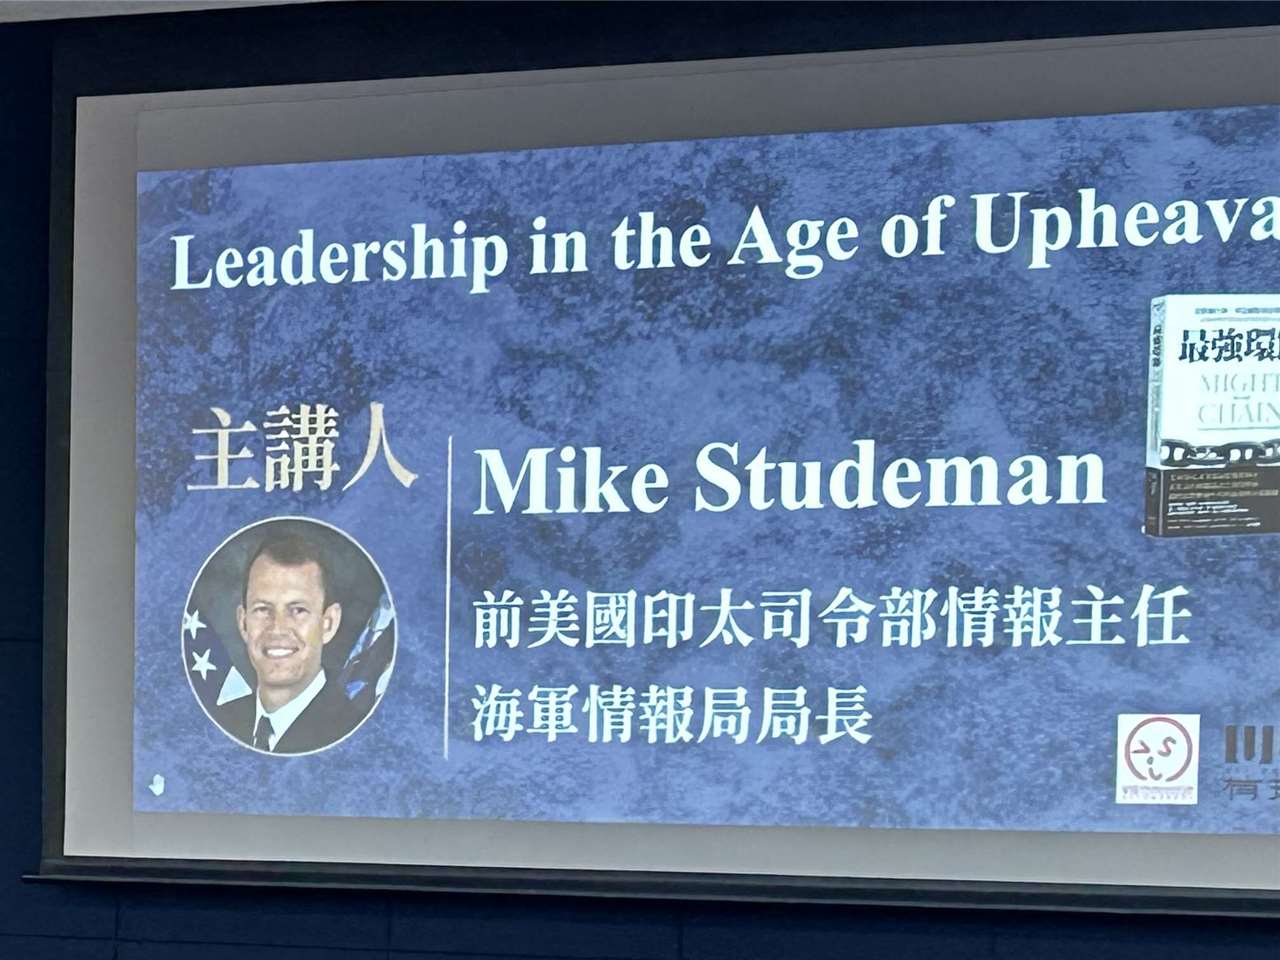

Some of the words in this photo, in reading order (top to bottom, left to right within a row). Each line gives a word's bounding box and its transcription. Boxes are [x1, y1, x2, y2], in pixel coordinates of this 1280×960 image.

[171, 221, 507, 294] Leadership
[530, 216, 588, 274] in
[612, 212, 710, 269] the
[727, 206, 858, 279] Age
[882, 195, 955, 257] of
[1179, 328, 1280, 363] 最強環
[187, 402, 418, 492] 主講人
[473, 446, 668, 514] Mike
[695, 440, 1107, 511] Studeman
[473, 584, 1191, 648] 前美國印太司令部情報主任
[472, 684, 872, 744] 海軍情報局局長
